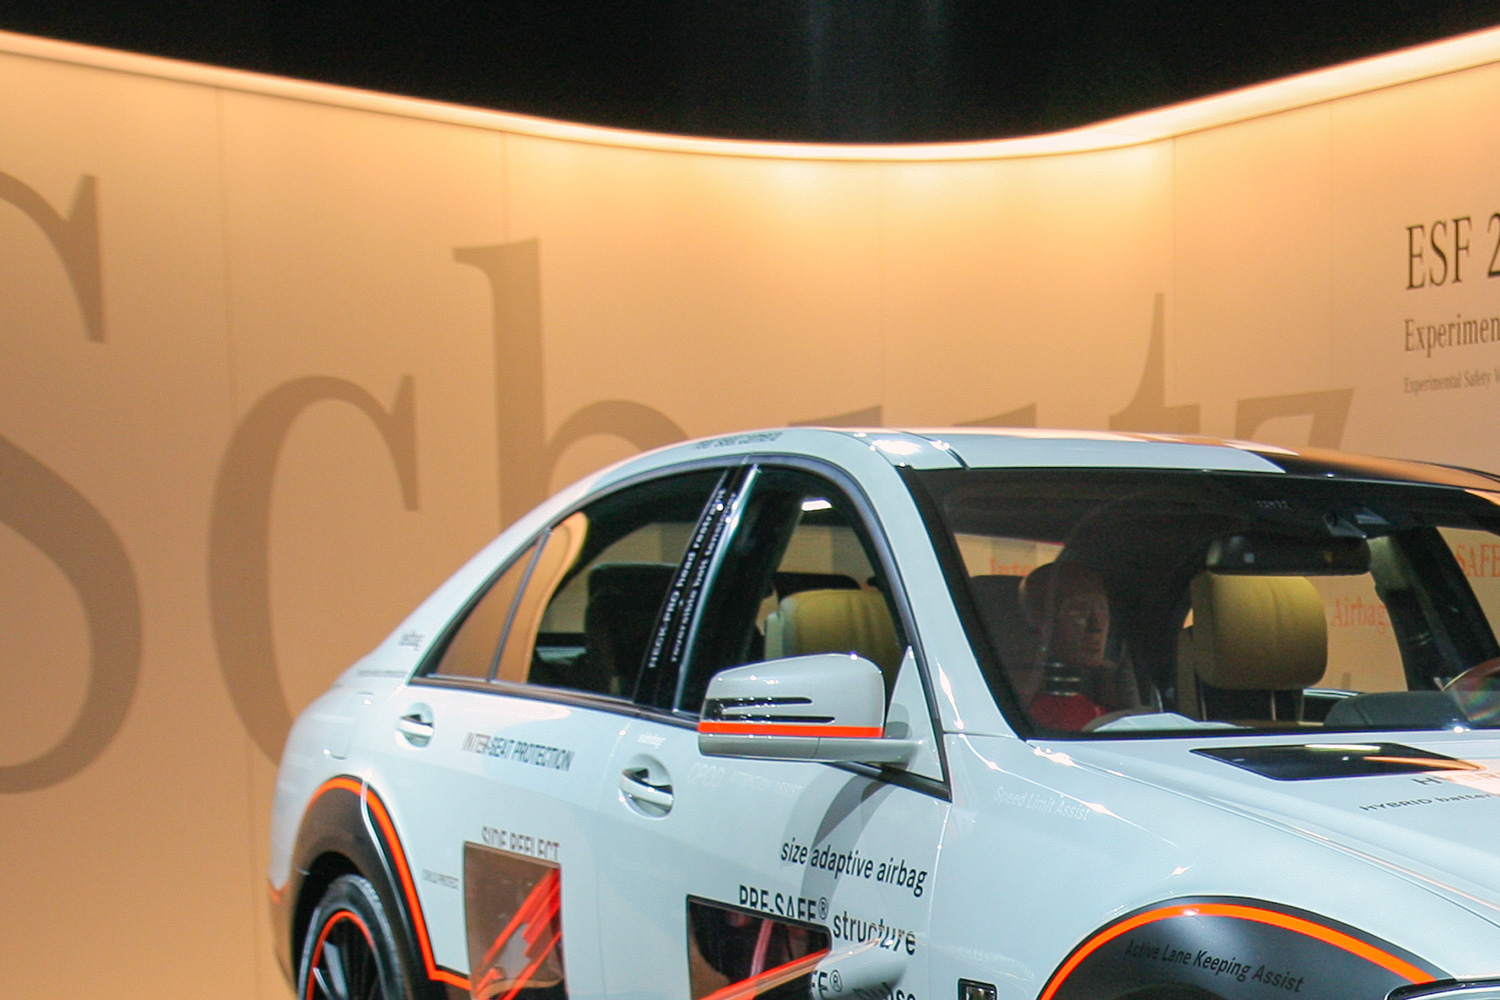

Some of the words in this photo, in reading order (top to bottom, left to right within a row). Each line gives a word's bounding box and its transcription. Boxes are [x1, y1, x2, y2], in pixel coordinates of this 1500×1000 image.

[1405, 215, 1472, 290] ESF
[675, 551, 697, 587] head
[994, 787, 1027, 807] Speed
[1027, 794, 1054, 814] Limit
[1056, 800, 1091, 821] Assist
[1360, 799, 1432, 811] HYBRID
[780, 837, 808, 867] size
[810, 844, 874, 880] adaptive
[876, 856, 928, 898] airbag
[833, 910, 917, 956] structure
[1161, 944, 1192, 965] Lane
[1192, 950, 1251, 983] Keeping
[1251, 964, 1305, 993] Assist
